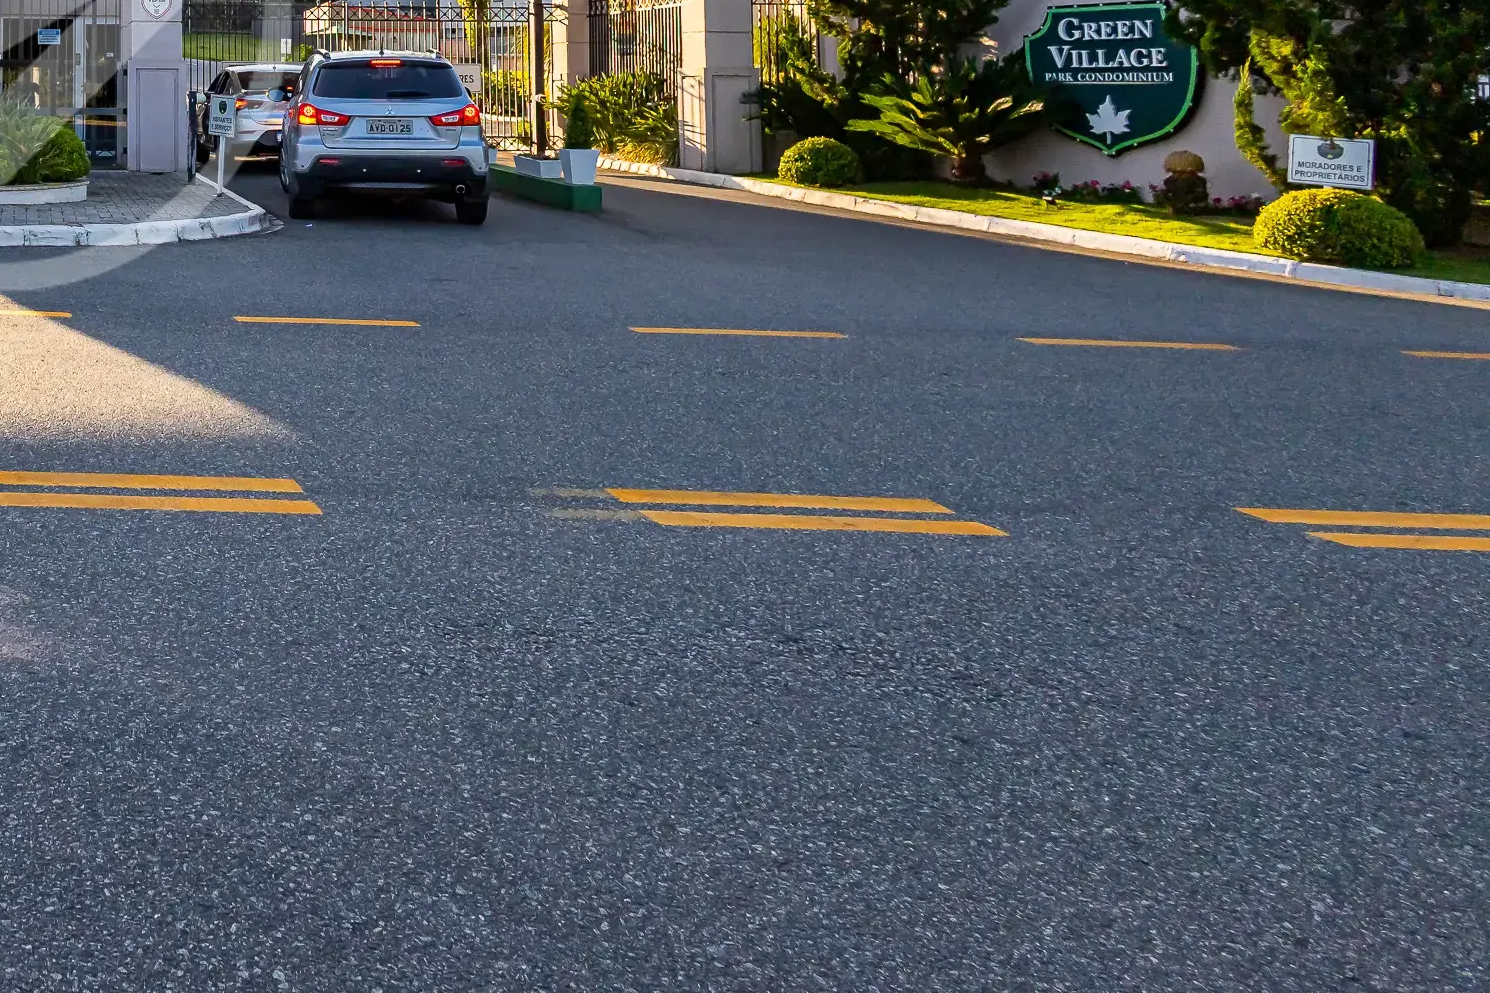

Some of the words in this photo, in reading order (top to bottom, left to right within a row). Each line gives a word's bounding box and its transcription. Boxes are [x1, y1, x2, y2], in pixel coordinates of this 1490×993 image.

[1057, 17, 1154, 41] GREEN
[1047, 45, 1169, 68] VILLAGE
[1045, 72, 1073, 82] PARK
[1077, 72, 1174, 82] CONDOMINIUM
[1297, 160, 1354, 173] MORADORES
[1356, 165, 1363, 173] E
[1294, 169, 1366, 183] PROPRIETÁRIOS
